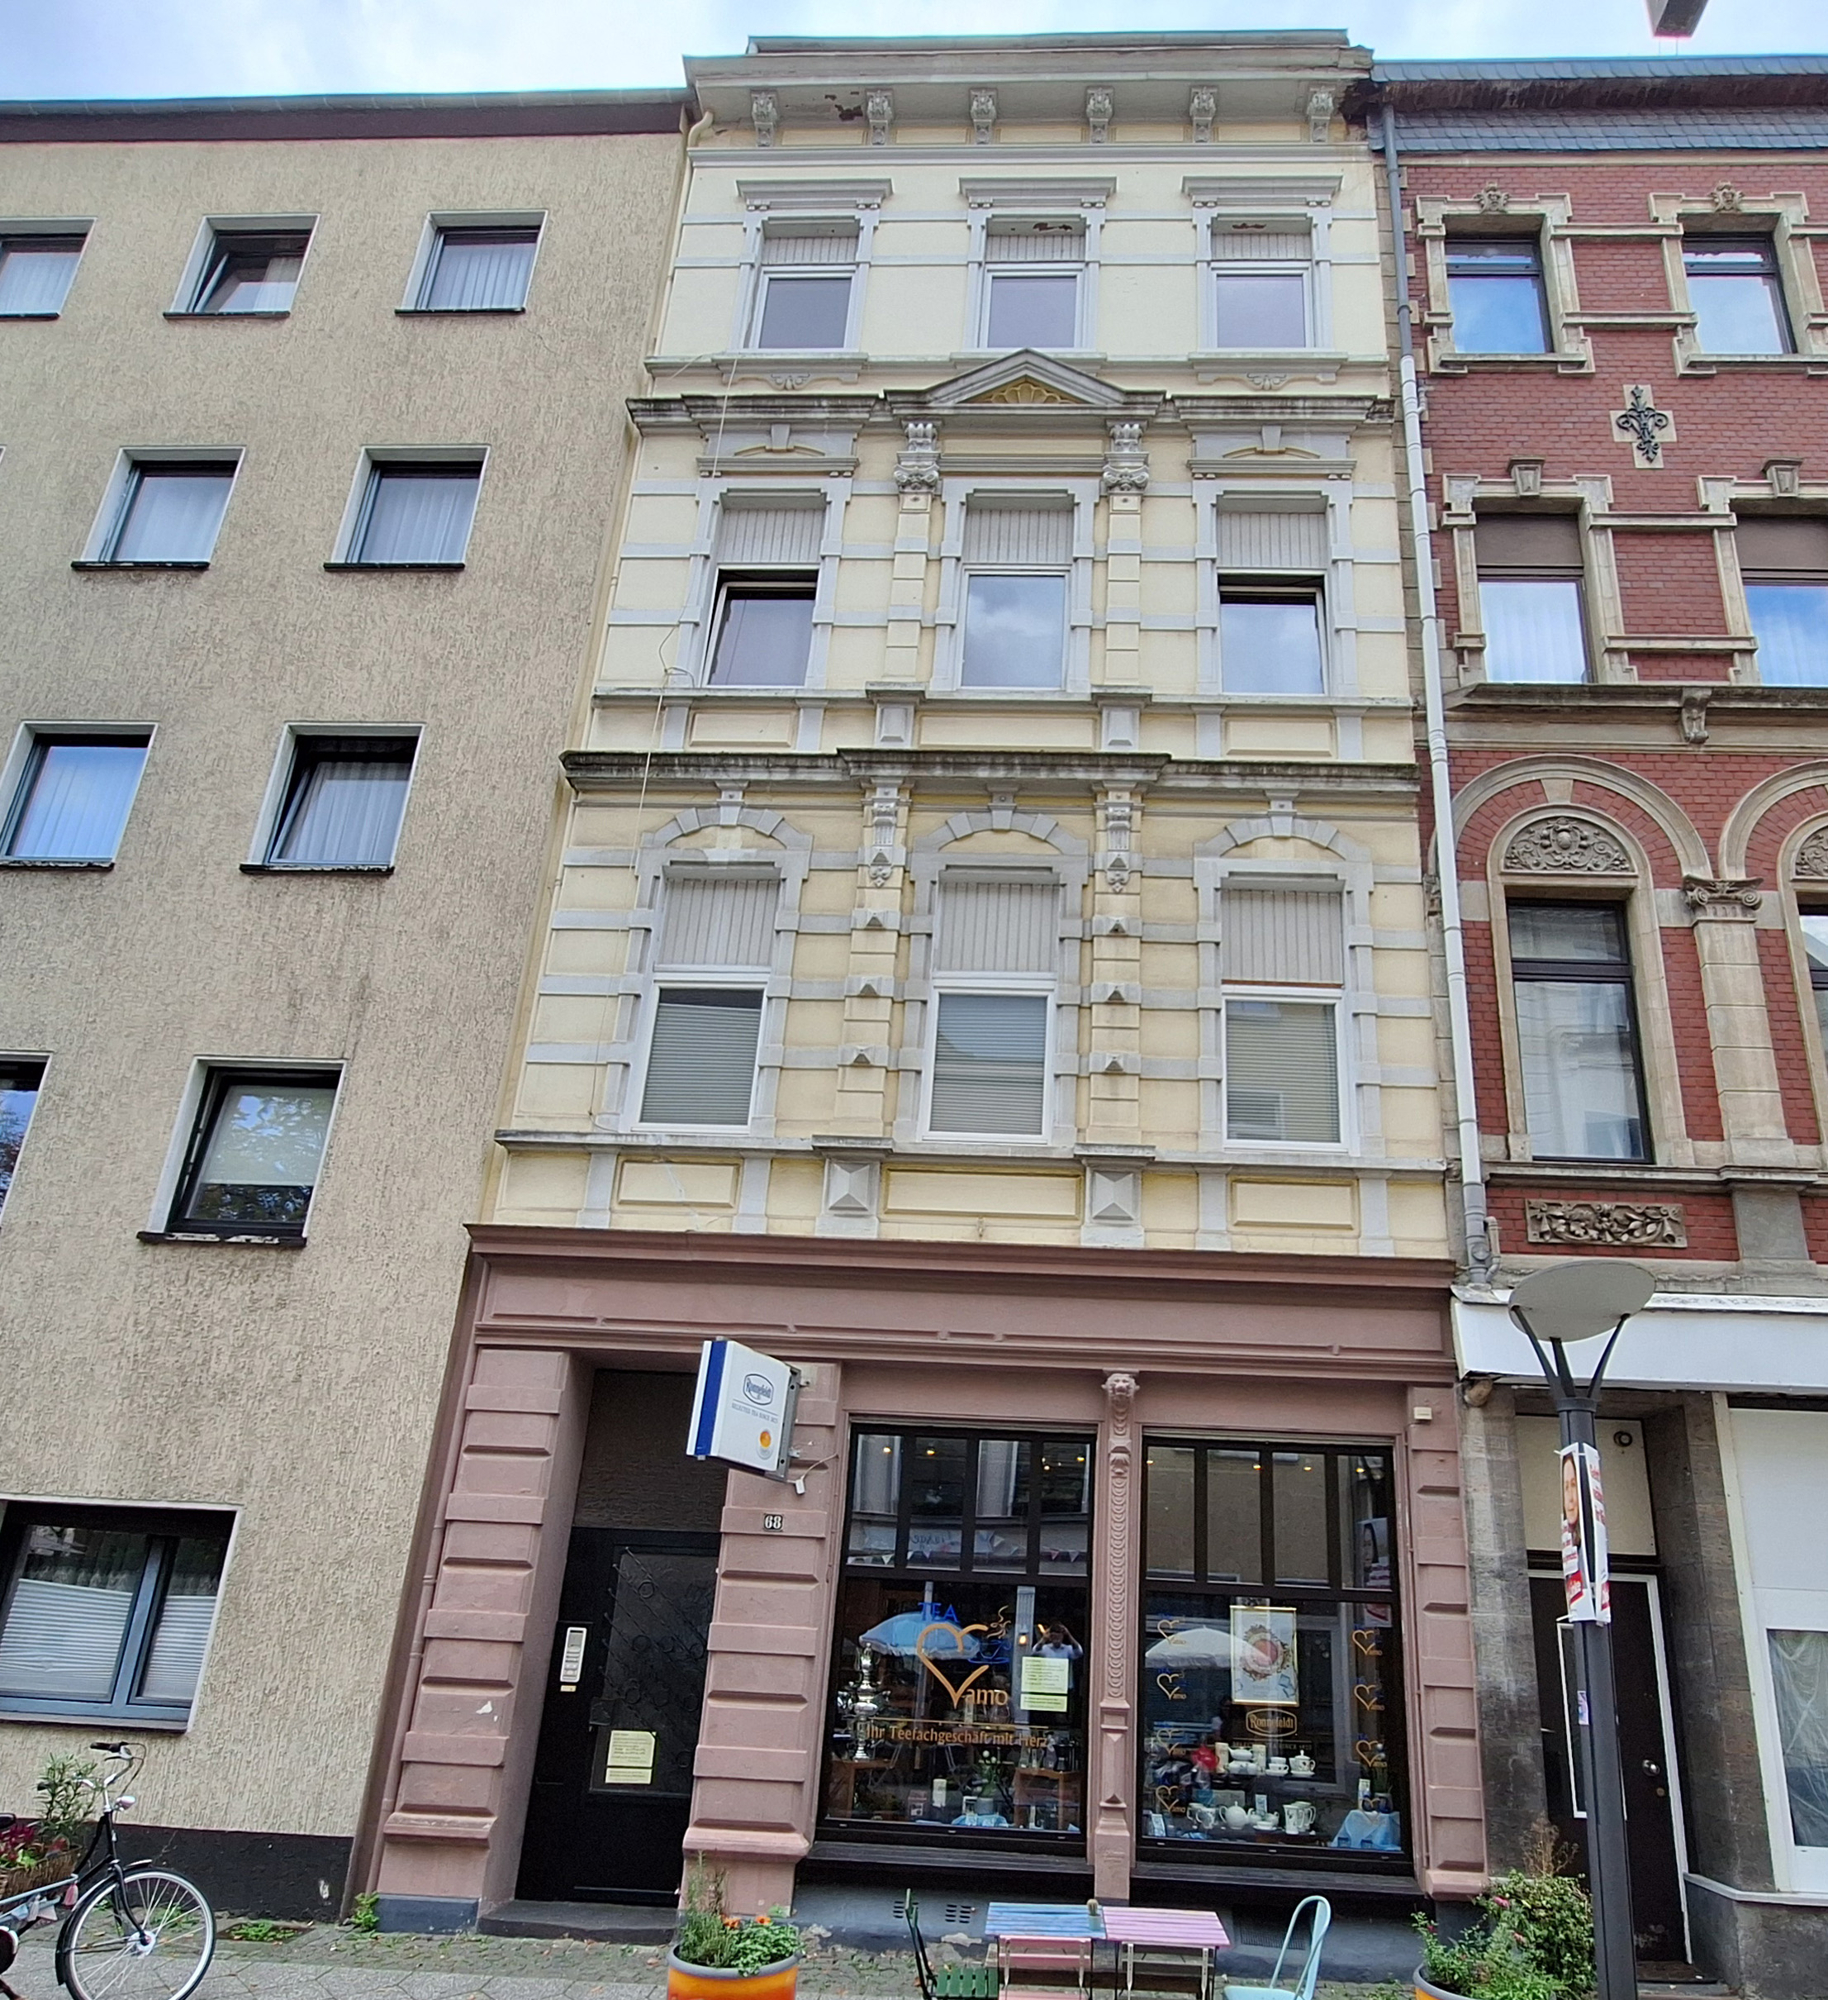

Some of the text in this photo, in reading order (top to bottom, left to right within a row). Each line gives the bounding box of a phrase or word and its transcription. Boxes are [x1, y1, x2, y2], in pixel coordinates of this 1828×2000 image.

[765, 1514, 781, 1529] 68
[918, 1602, 958, 1623] TEA
[866, 1725, 885, 1739] Ihr
[889, 1725, 991, 1744] Teefachgeschäft
[992, 1732, 1013, 1745] mit
